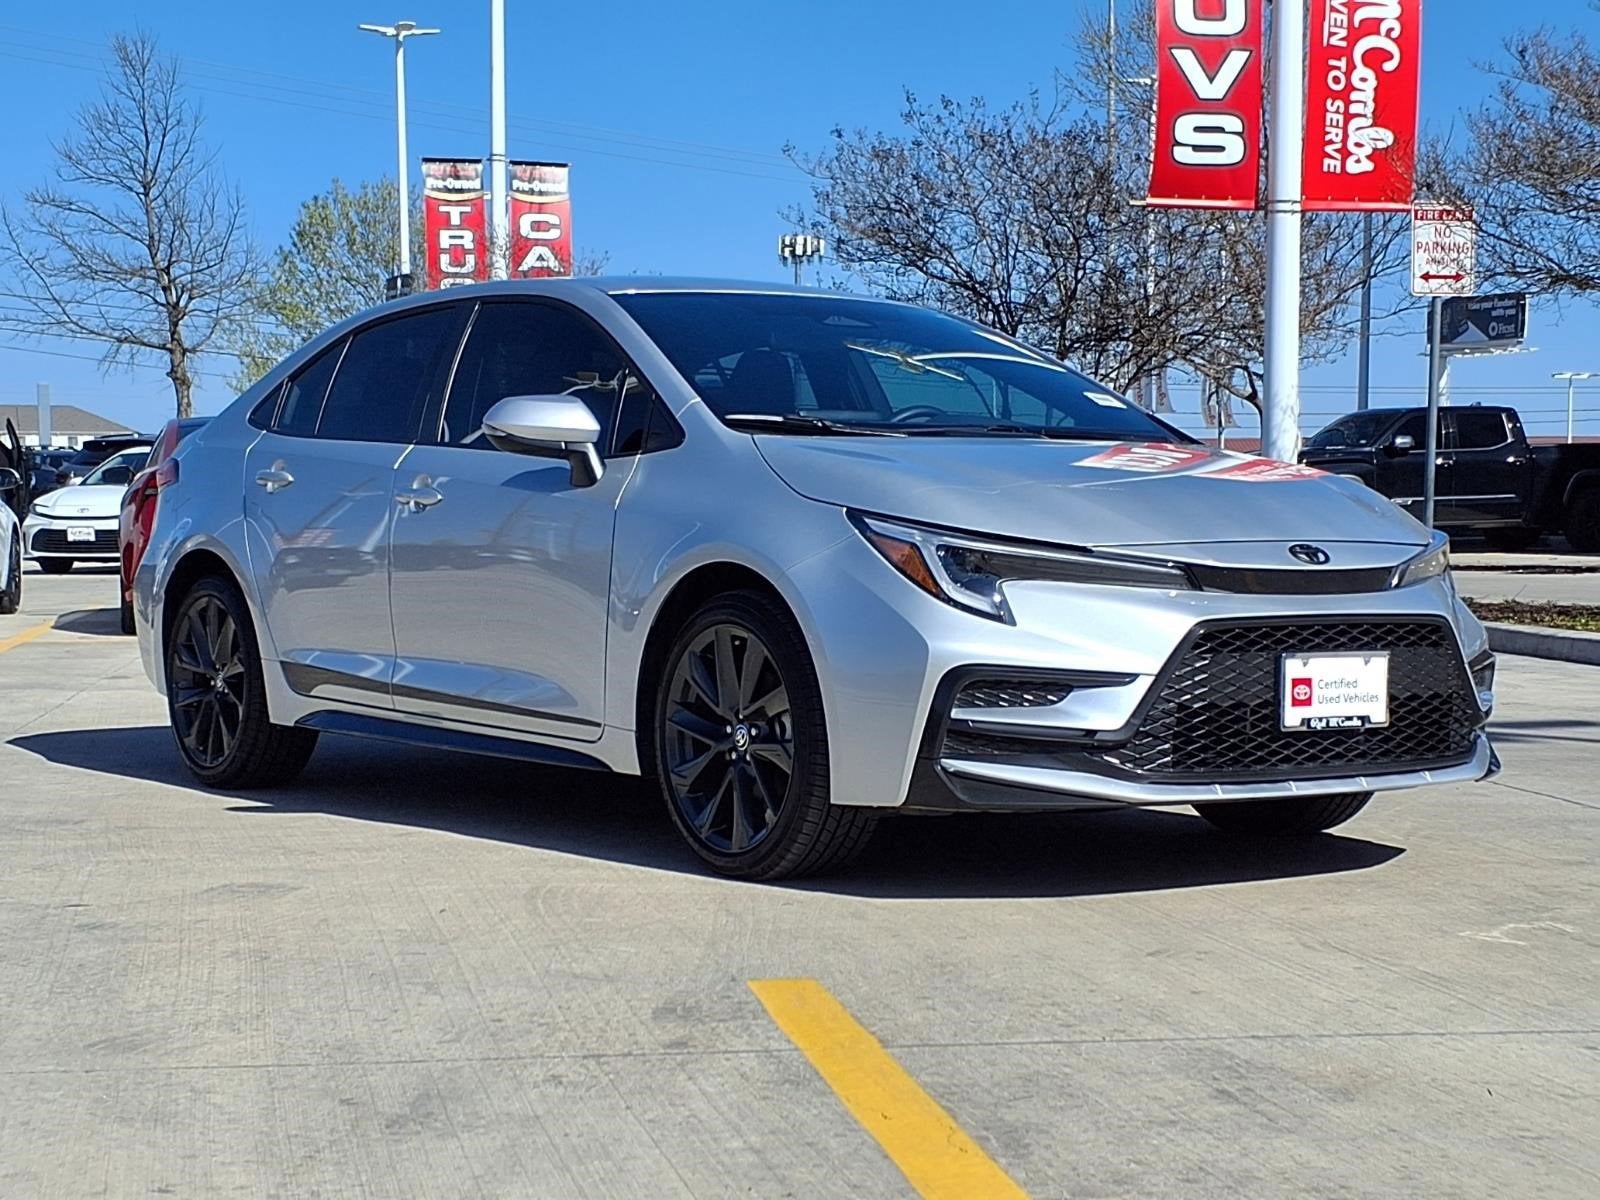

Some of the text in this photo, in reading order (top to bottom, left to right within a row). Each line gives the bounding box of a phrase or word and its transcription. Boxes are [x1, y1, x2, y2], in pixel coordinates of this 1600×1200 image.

[1327, 56, 1347, 91] TO
[1323, 97, 1345, 174] SERVE
[1417, 210, 1440, 220] FIRE
[1434, 225, 1452, 238] NO
[1416, 241, 1469, 254] PARKING
[1318, 678, 1358, 689] Certified
[1318, 692, 1379, 704] Used Vehicles
